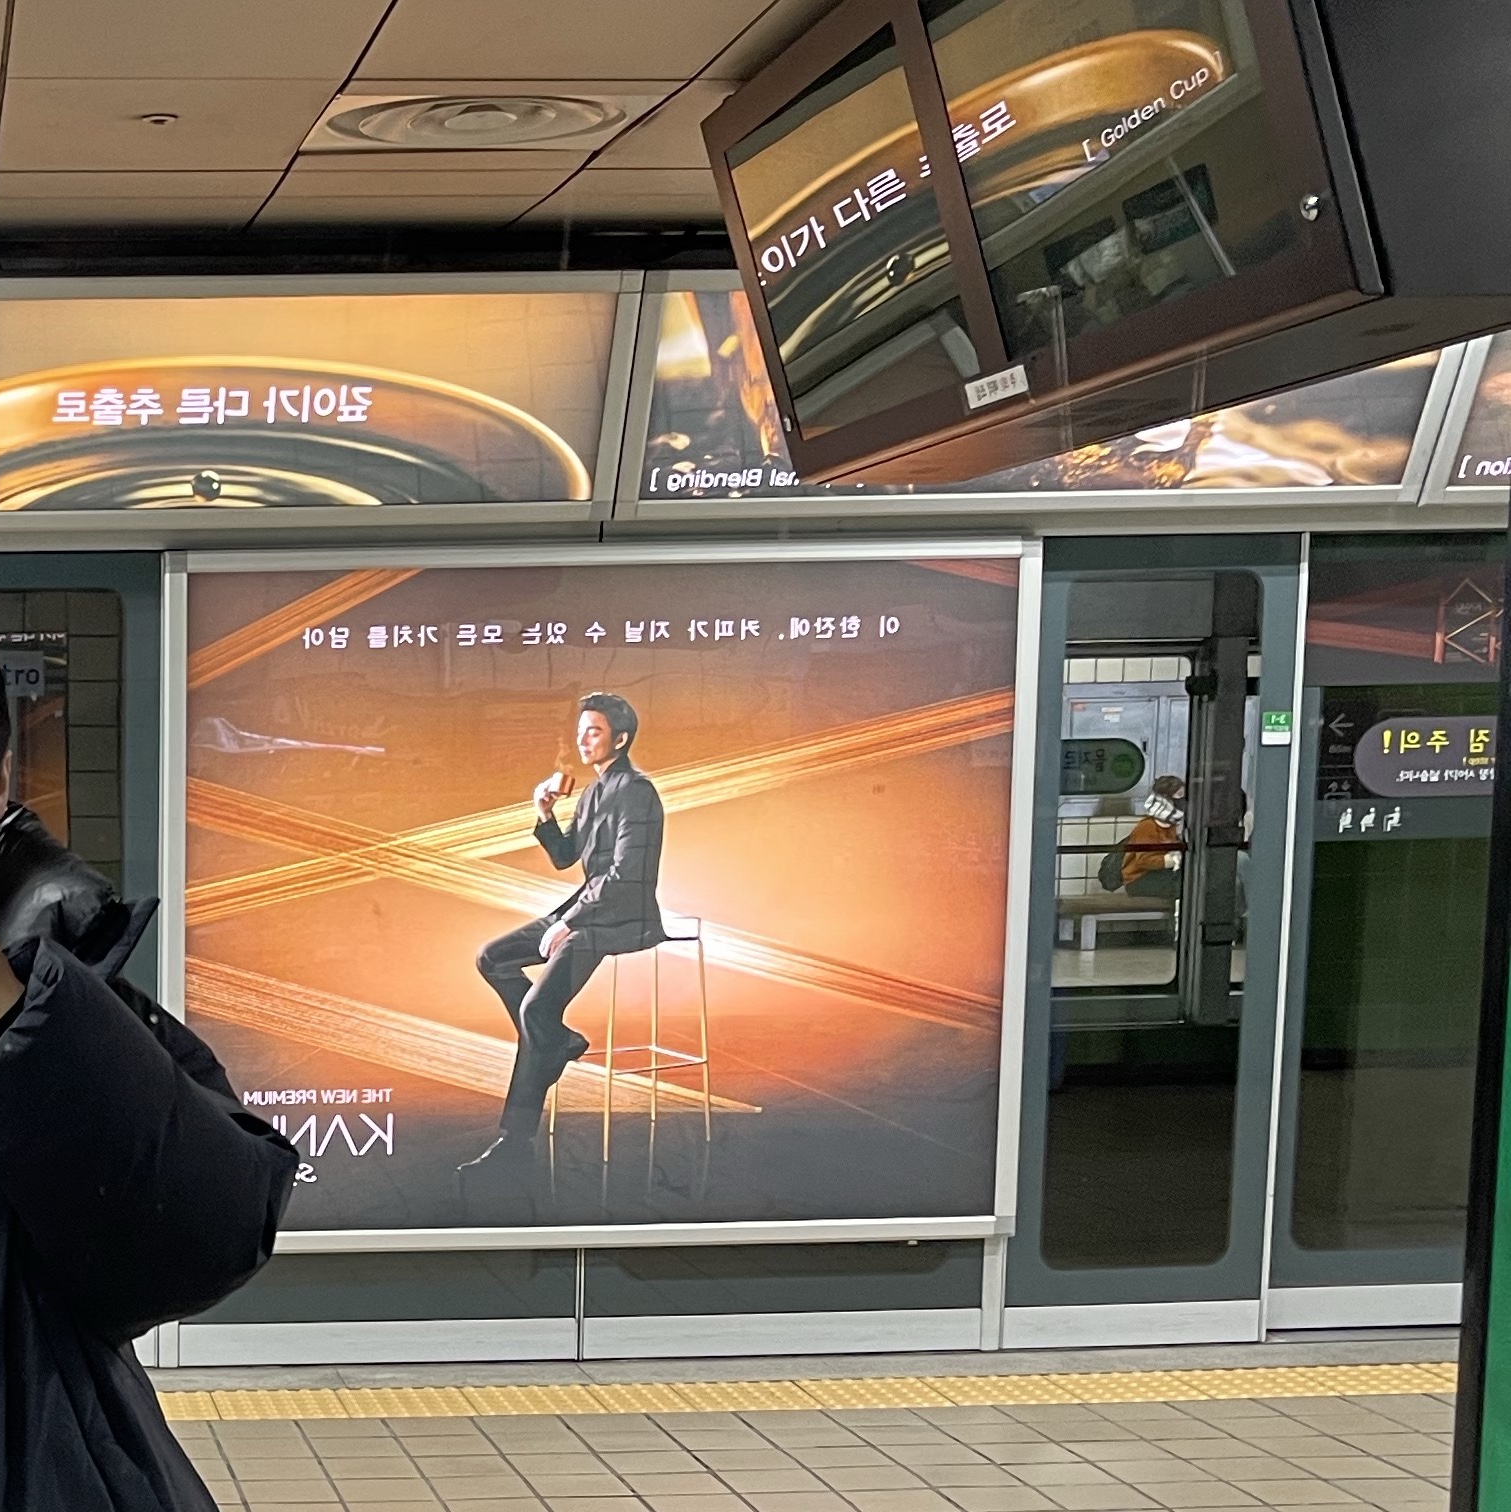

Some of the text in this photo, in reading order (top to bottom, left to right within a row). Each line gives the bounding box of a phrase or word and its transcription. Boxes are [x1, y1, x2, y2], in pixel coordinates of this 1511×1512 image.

[1100, 97, 1167, 148] Golden
[1169, 67, 1210, 101] Cup
[758, 216, 827, 287] 이가
[832, 168, 907, 229] 다른
